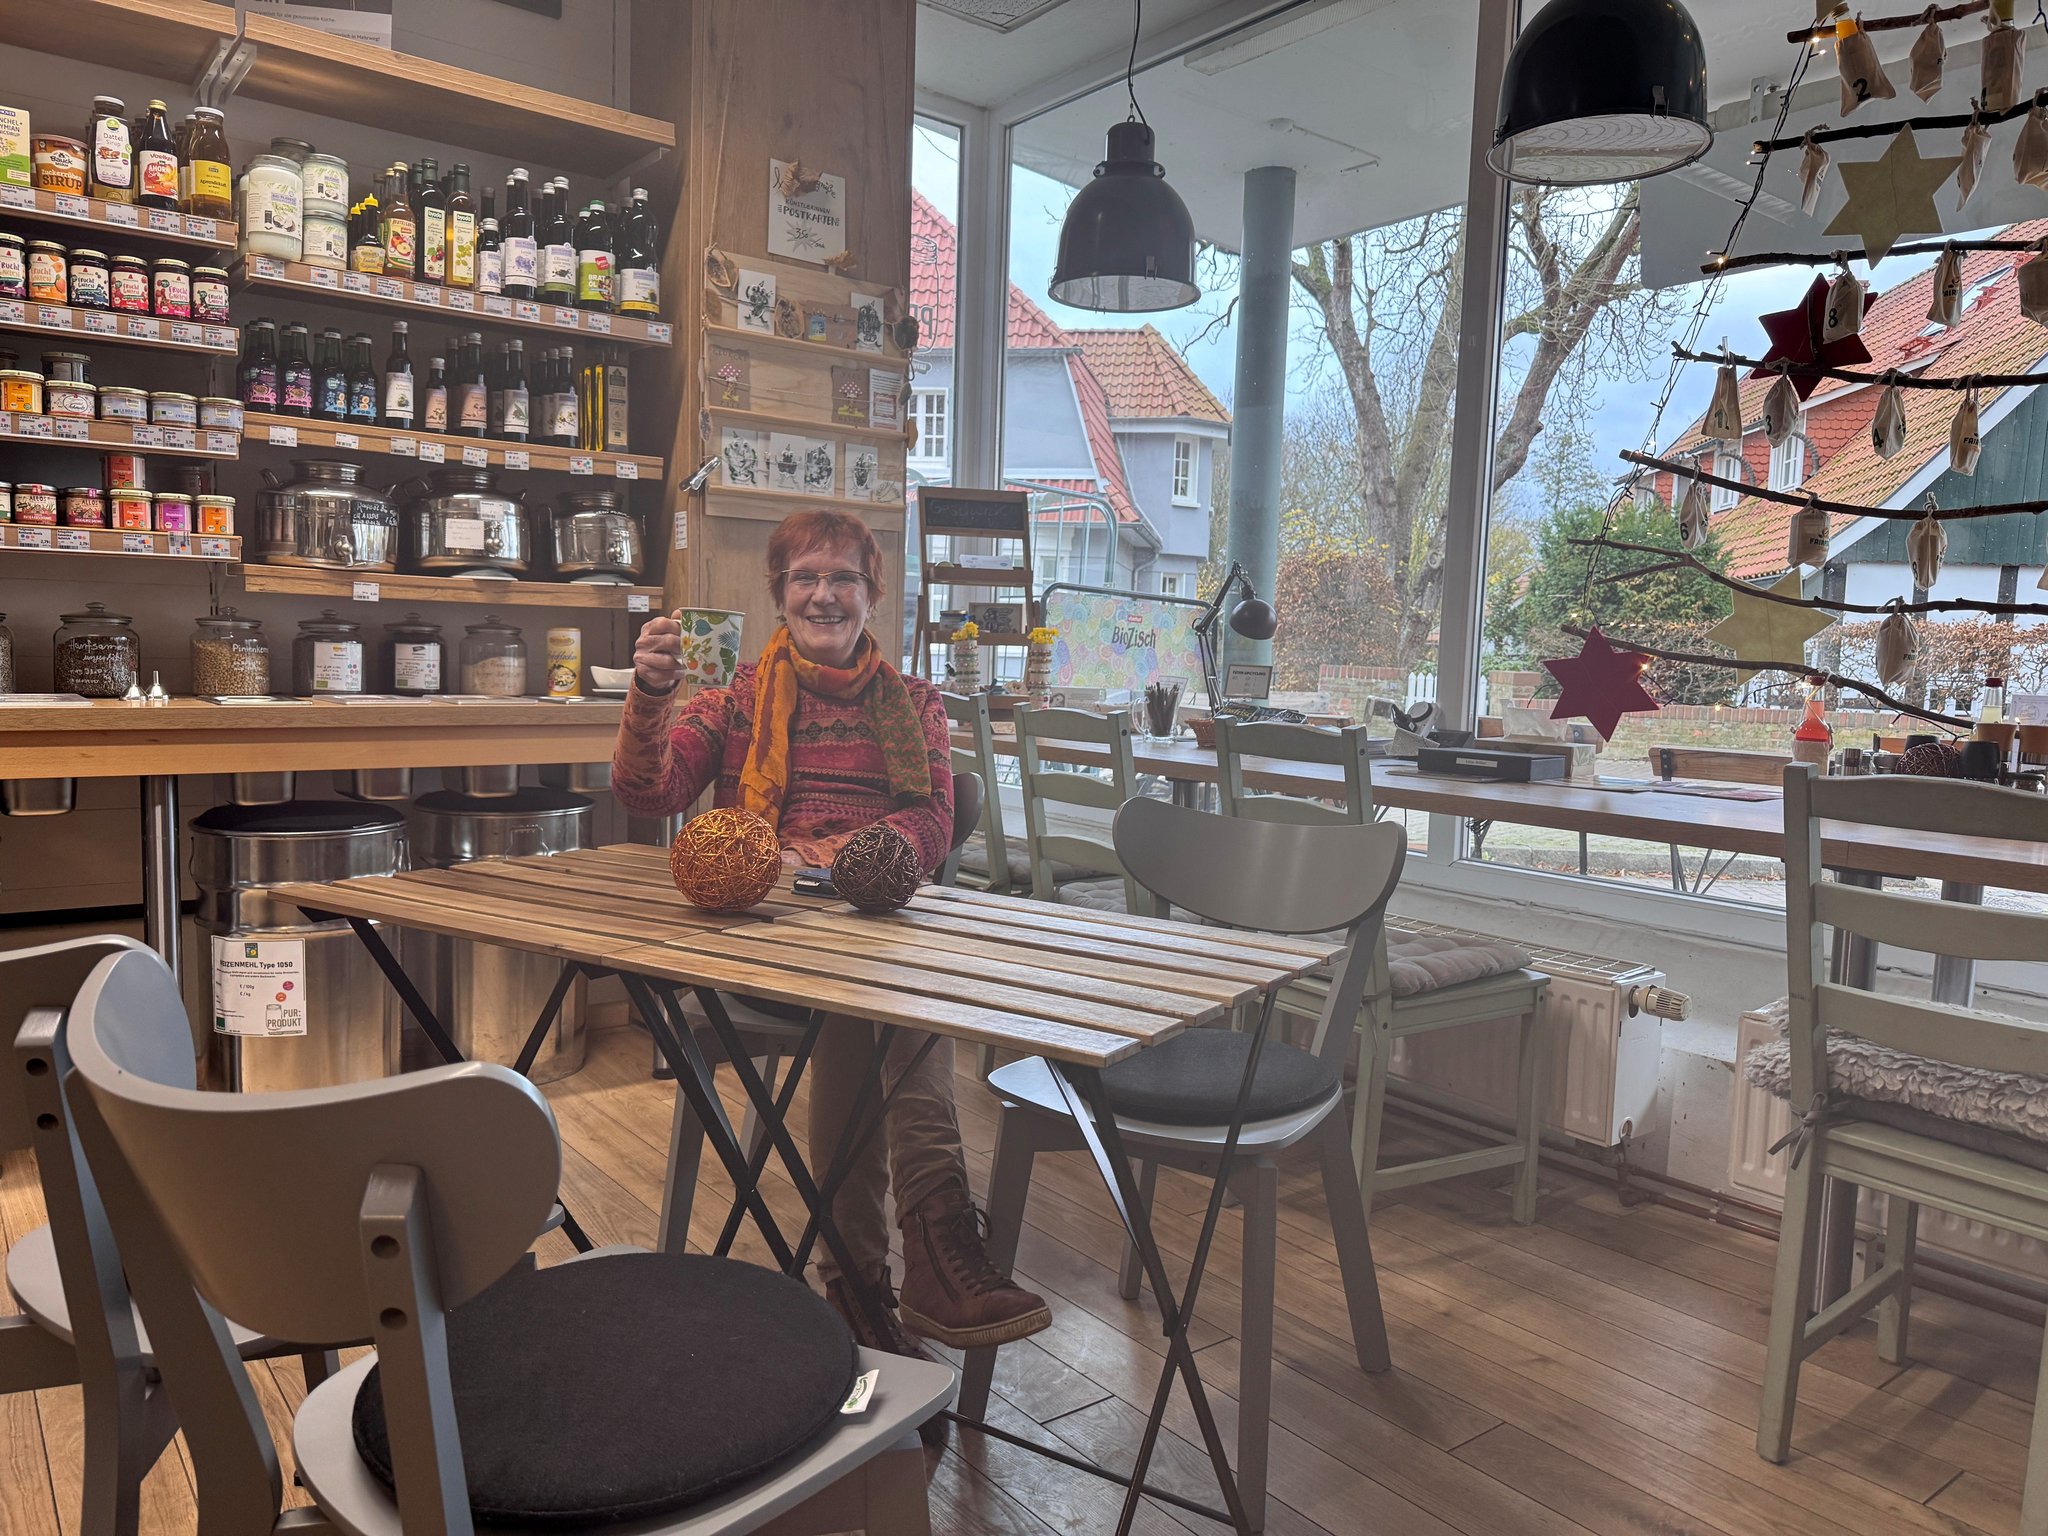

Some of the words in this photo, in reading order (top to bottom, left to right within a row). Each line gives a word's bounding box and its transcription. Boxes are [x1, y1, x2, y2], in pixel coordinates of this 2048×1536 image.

[1853, 78, 1871, 102] 2
[103, 132, 124, 142] Dattel
[42, 174, 82, 190] SIRUP
[783, 205, 836, 226] POSTKARTEN
[588, 273, 605, 282] BRAT
[1828, 308, 1838, 328] 8
[1873, 428, 1884, 449] 4
[1680, 522, 1689, 541] 6
[68, 638, 129, 654] Hanfsamen
[1111, 626, 1156, 650] BioZisch
[259, 961, 275, 969] Type
[283, 1008, 301, 1018] PUR:
[267, 1017, 302, 1028] PRODUKT
